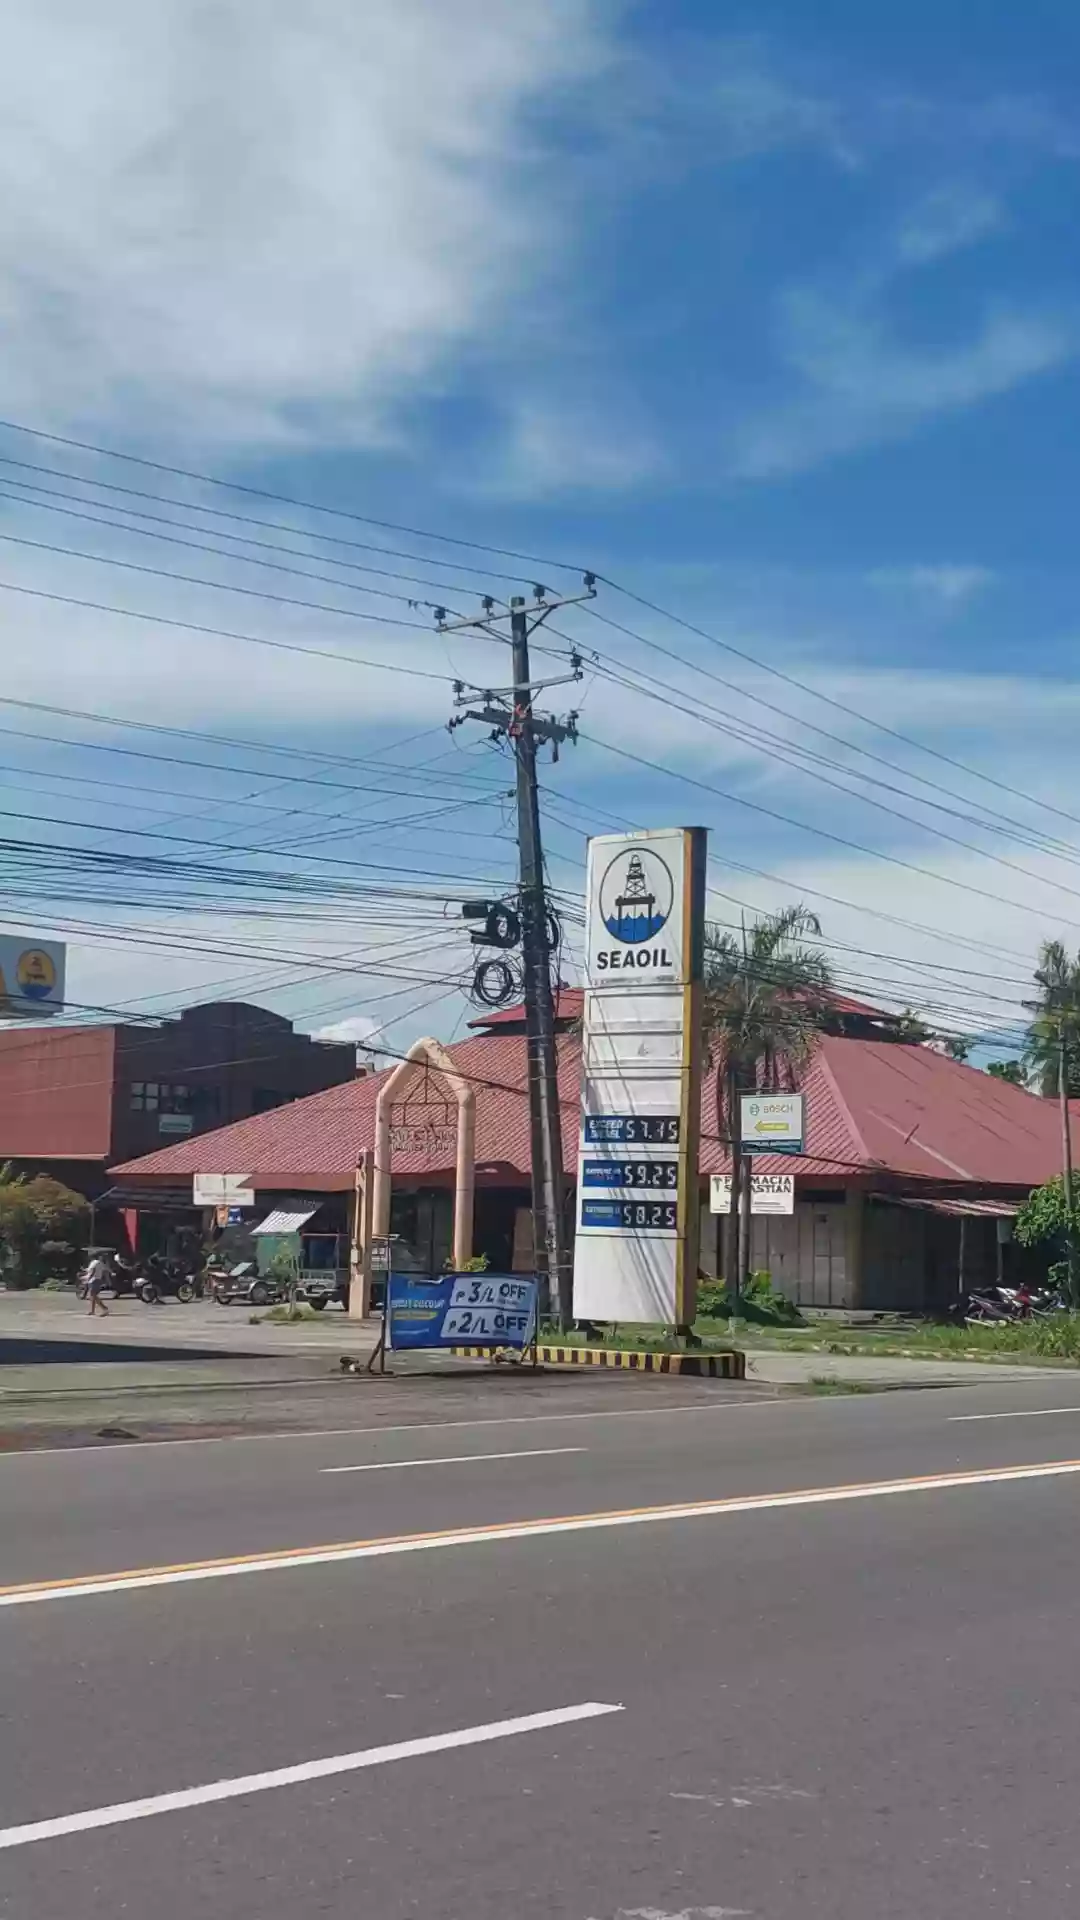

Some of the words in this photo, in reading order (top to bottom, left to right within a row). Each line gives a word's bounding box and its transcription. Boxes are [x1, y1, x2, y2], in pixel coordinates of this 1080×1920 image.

[597, 948, 672, 970] SEAOIL
[763, 1104, 793, 1113] BOSCH
[624, 1165, 676, 1185] 59.25
[724, 1176, 791, 1185] FMACIA
[499, 1283, 527, 1299] OFF
[493, 1314, 528, 1331] OFF
